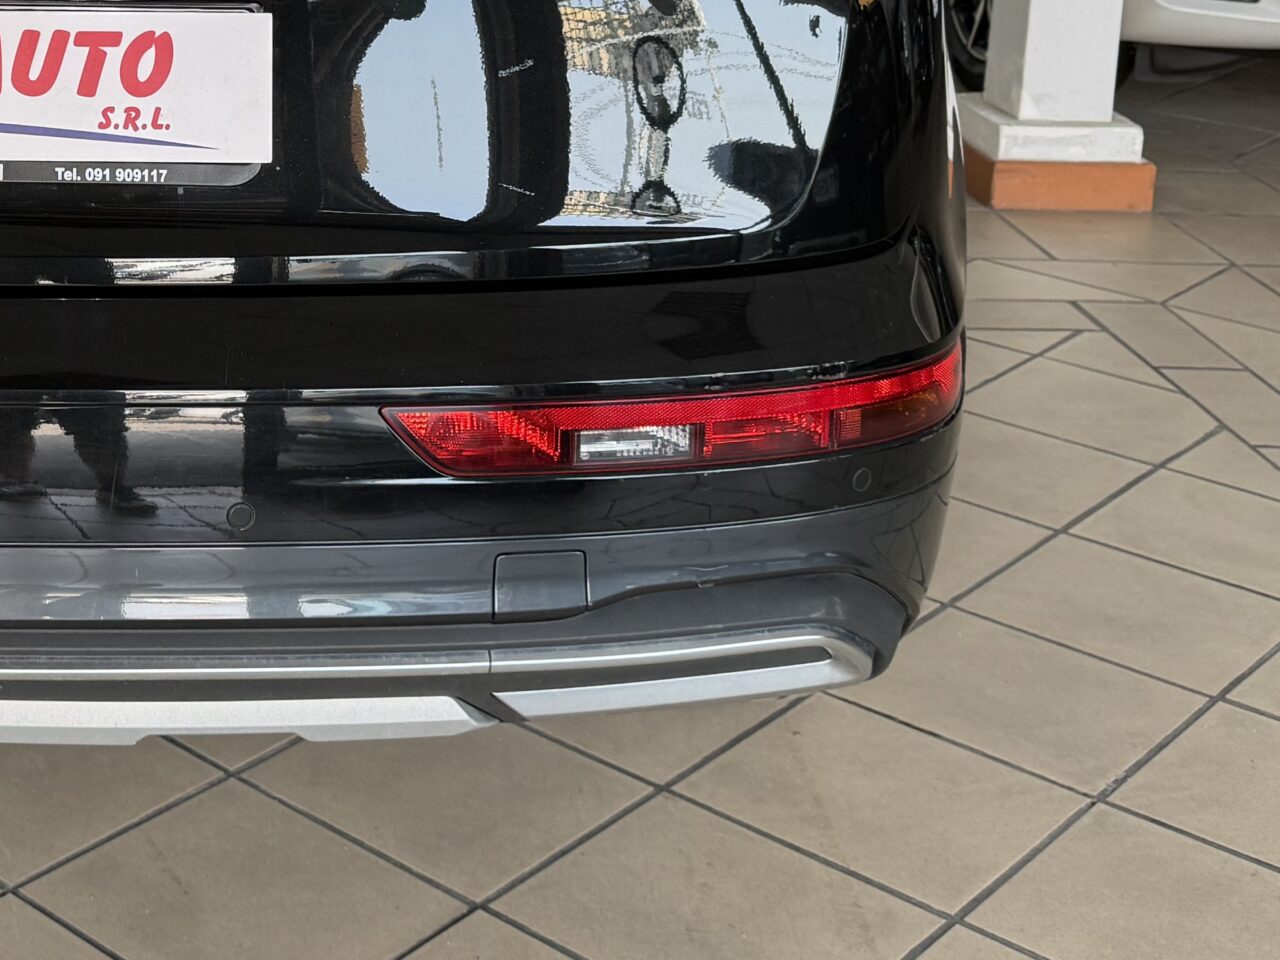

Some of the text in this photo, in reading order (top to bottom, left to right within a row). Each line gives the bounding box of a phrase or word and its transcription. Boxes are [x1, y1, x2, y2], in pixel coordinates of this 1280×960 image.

[97, 105, 171, 132] S.R.L.
[54, 167, 168, 183] Tel. 091 909117
